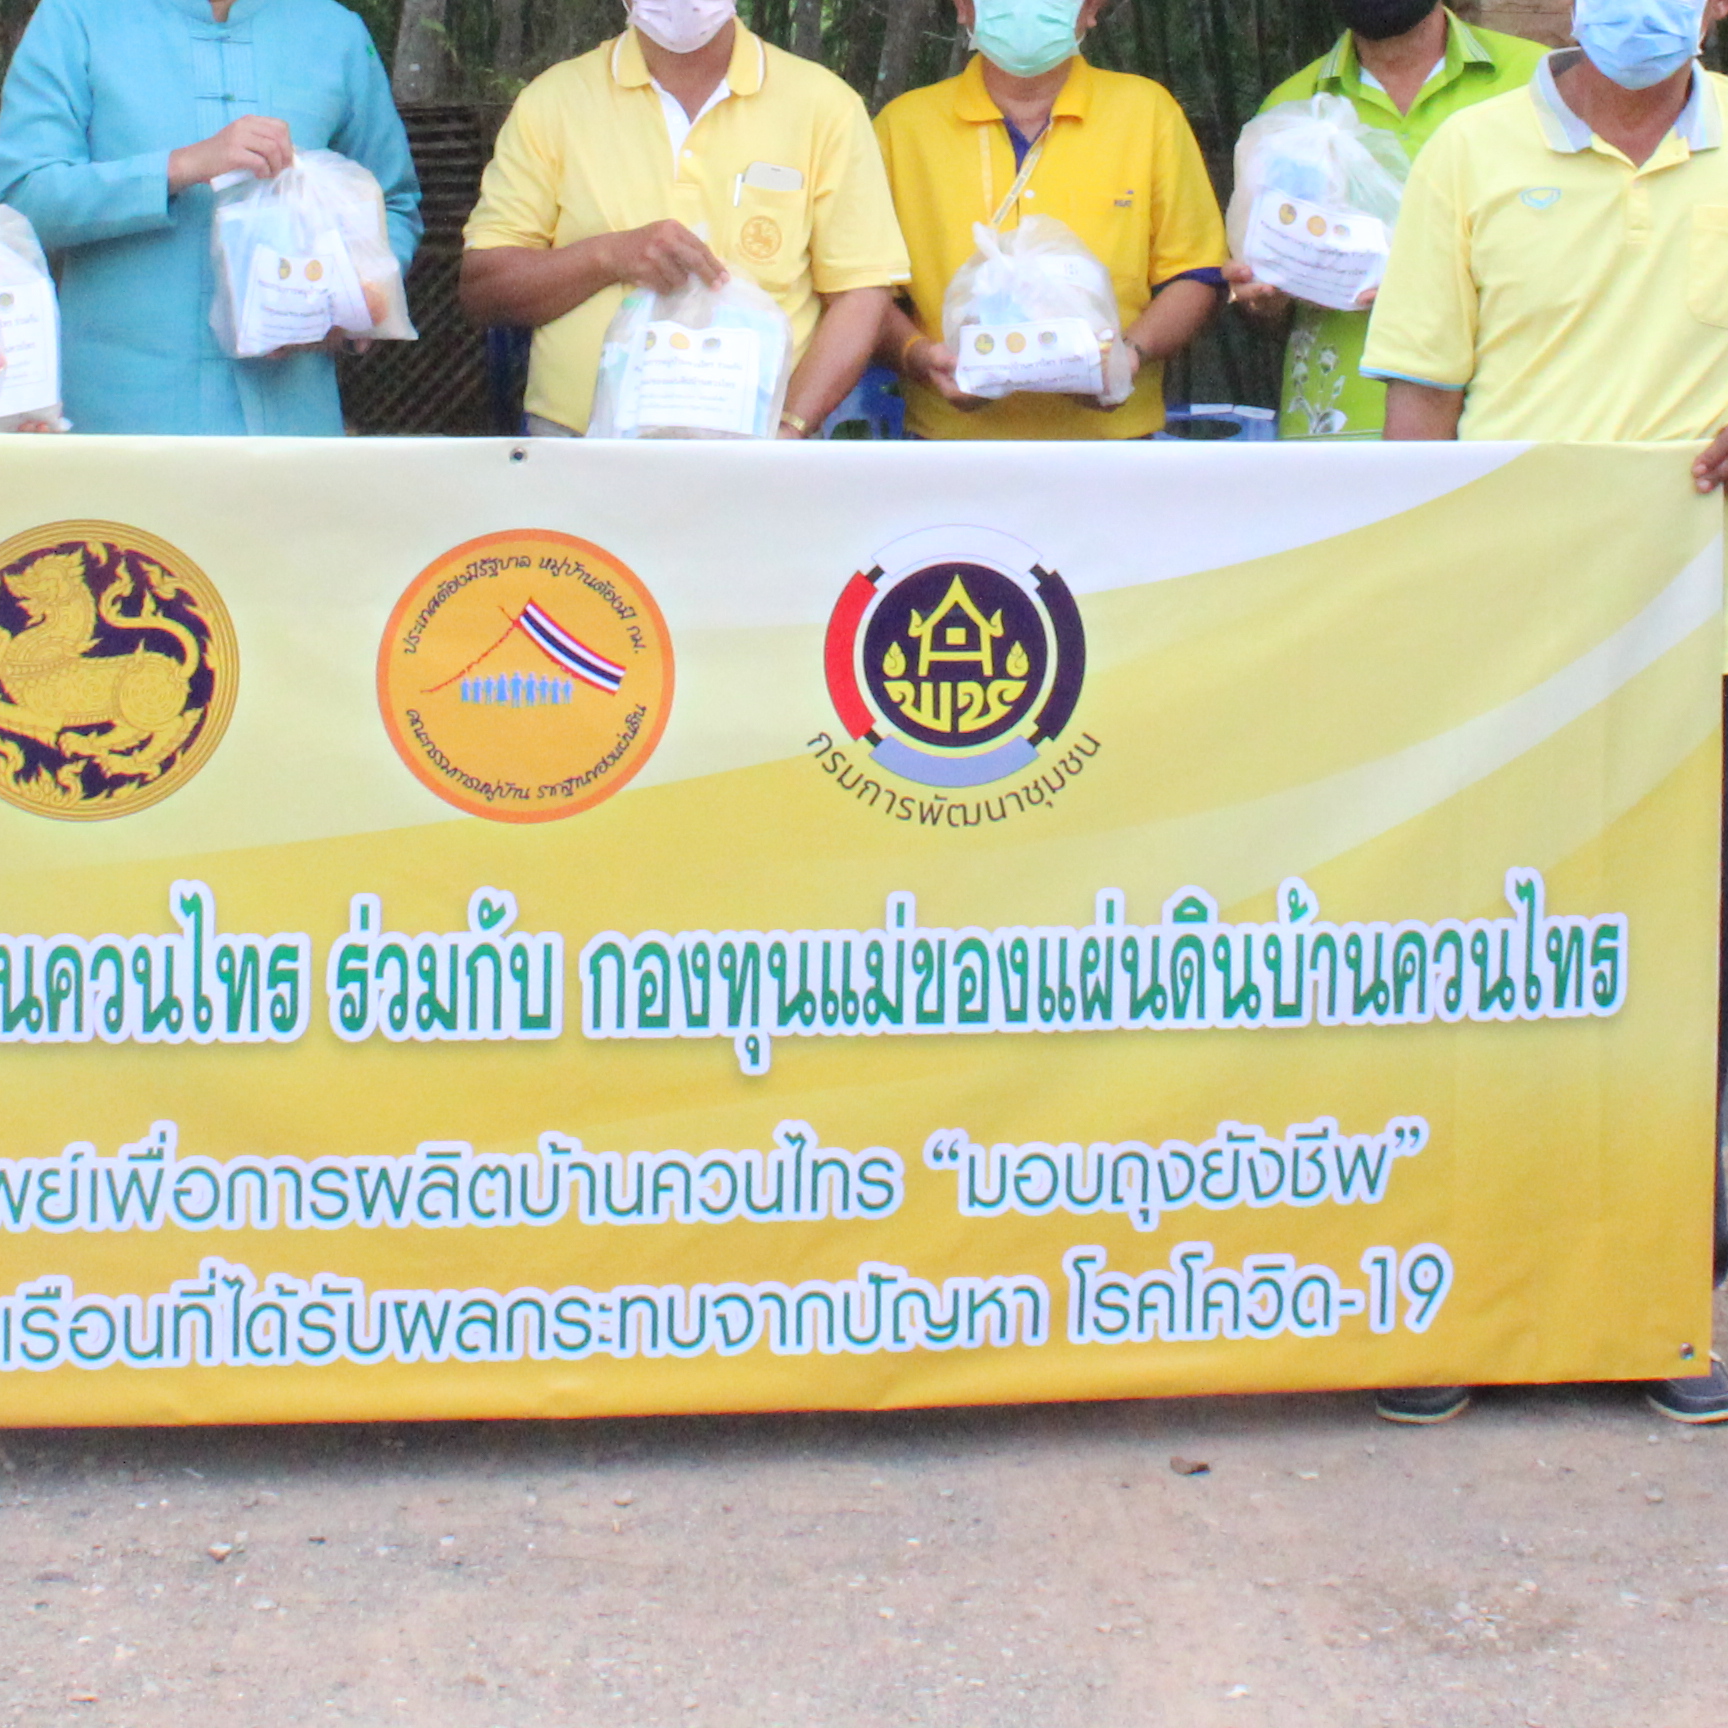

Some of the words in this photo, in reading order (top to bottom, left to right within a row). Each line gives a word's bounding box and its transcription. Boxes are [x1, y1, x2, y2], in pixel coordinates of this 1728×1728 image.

[806, 731, 1102, 828] กรมการพัฒนาชุมชน
[334, 899, 555, 1036] ร่วมกับ
[586, 876, 1624, 1068] กองทุนแม่ของแผ่นดินบ้านควนไทร
[1071, 1251, 1450, 1340] โรคโควิด-19
